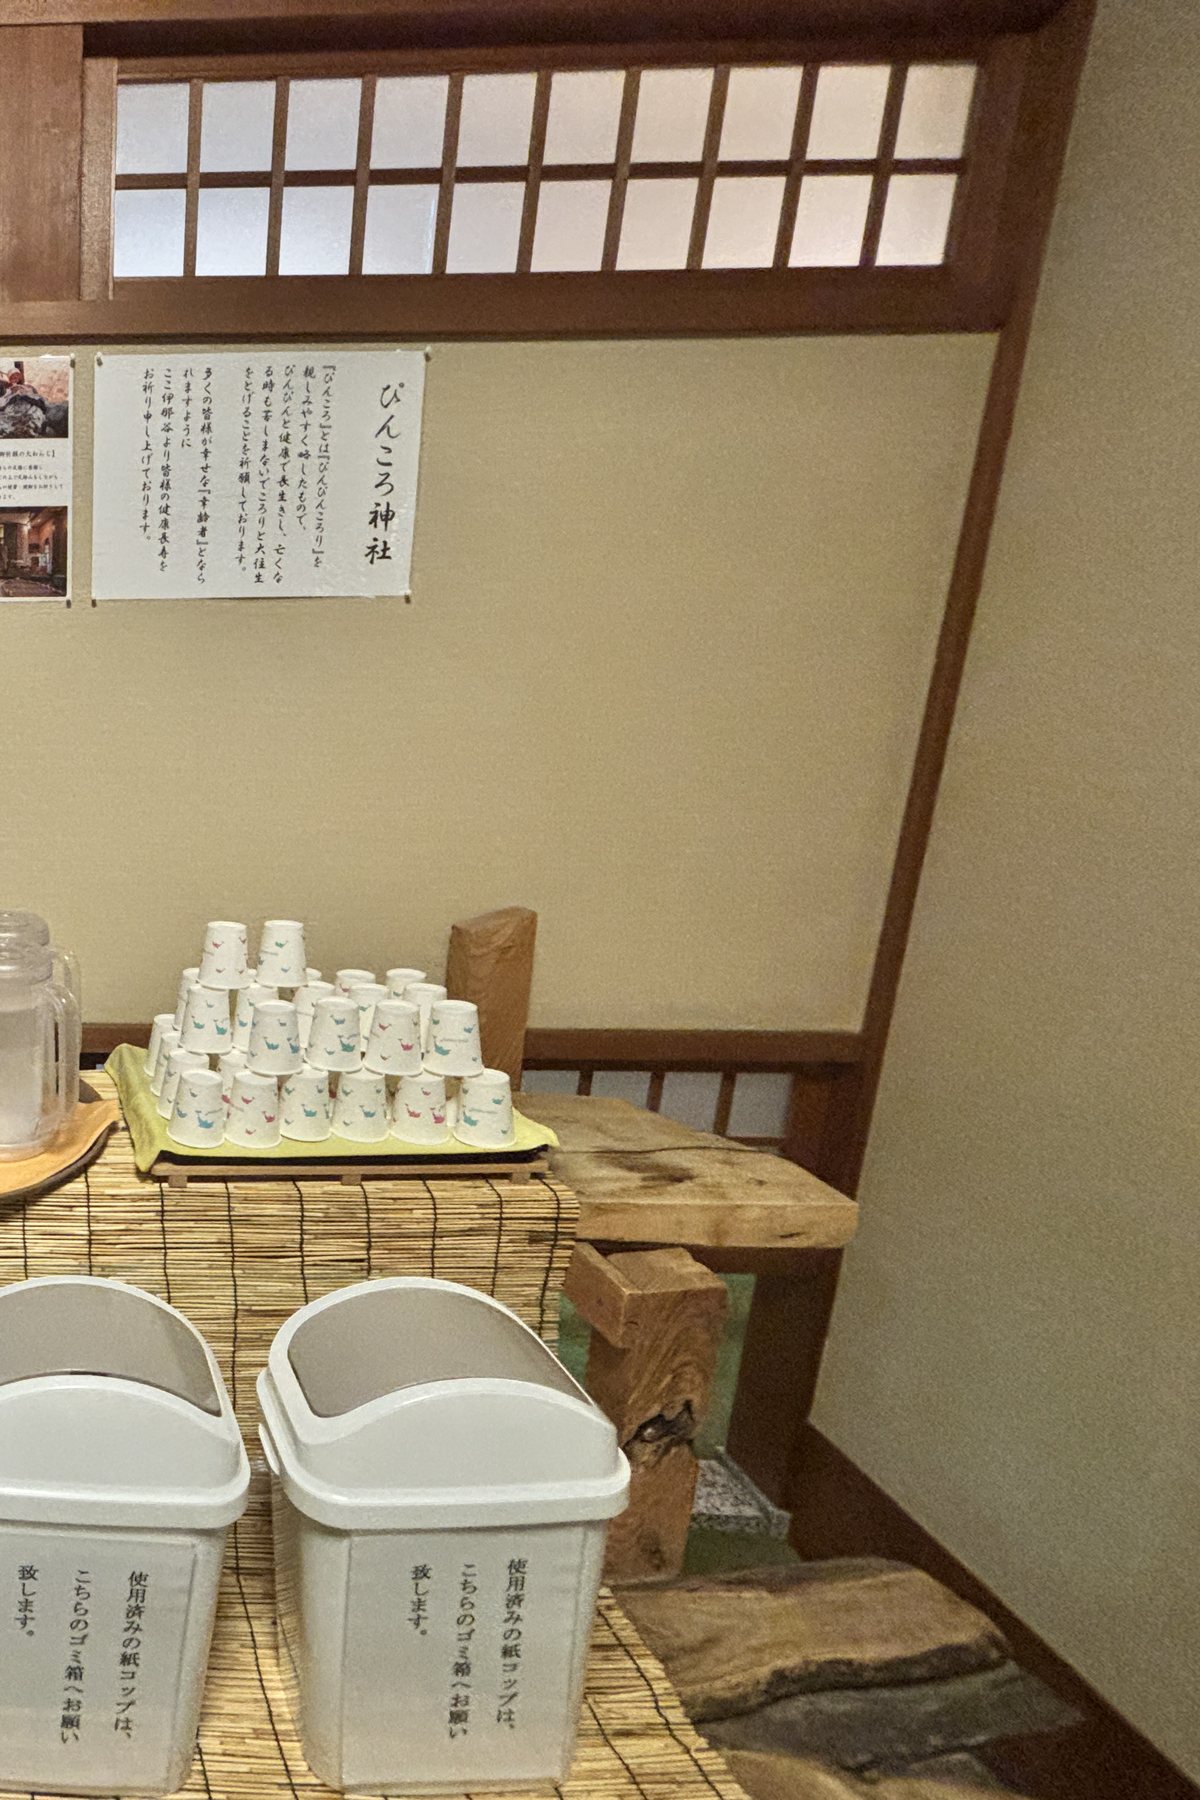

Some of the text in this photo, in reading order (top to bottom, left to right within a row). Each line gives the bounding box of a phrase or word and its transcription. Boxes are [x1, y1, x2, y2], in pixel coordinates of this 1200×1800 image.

[139, 368, 155, 541] お祈り申し上げております。
[180, 367, 194, 449] れますように
[234, 366, 255, 572] をとげることを祈願しております。
[363, 381, 406, 566] ぴんころ神社
[14, 1564, 40, 1638] 致します。
[59, 1568, 92, 1745] こちらのゴミ箱へお願い
[113, 1570, 150, 1740] 使用済みの紙コップは、
[406, 1563, 433, 1637] 致します。
[447, 1562, 478, 1740] こちらのゴミ箱へお願い
[495, 1557, 529, 1731] 使用済みの紙コップは、
